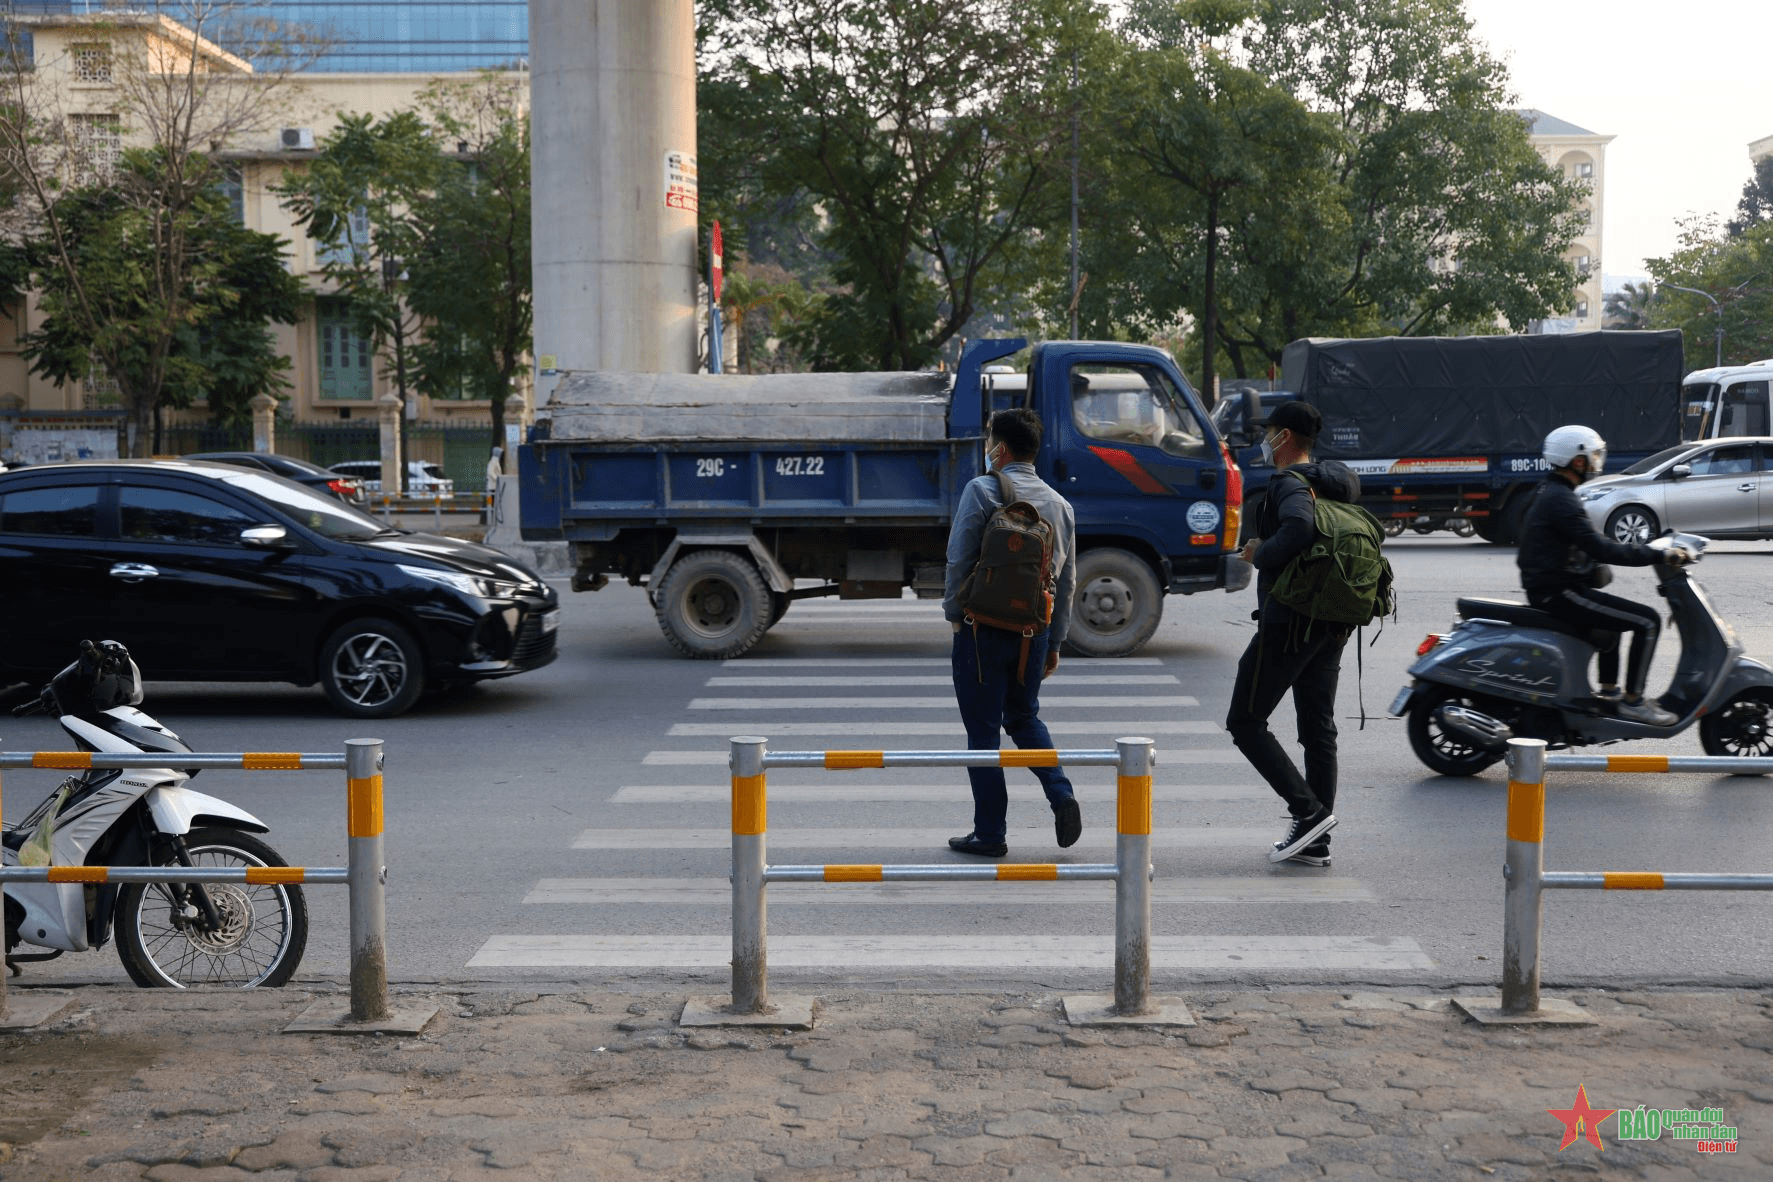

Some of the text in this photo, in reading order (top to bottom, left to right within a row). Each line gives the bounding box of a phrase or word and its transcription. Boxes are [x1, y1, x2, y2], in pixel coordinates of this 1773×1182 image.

[696, 458, 724, 477] 29C
[776, 457, 825, 476] 427.22
[1511, 458, 1555, 472] 89C-104.
[1457, 659, 1557, 686] Sprint
[120, 780, 149, 788] HONDA
